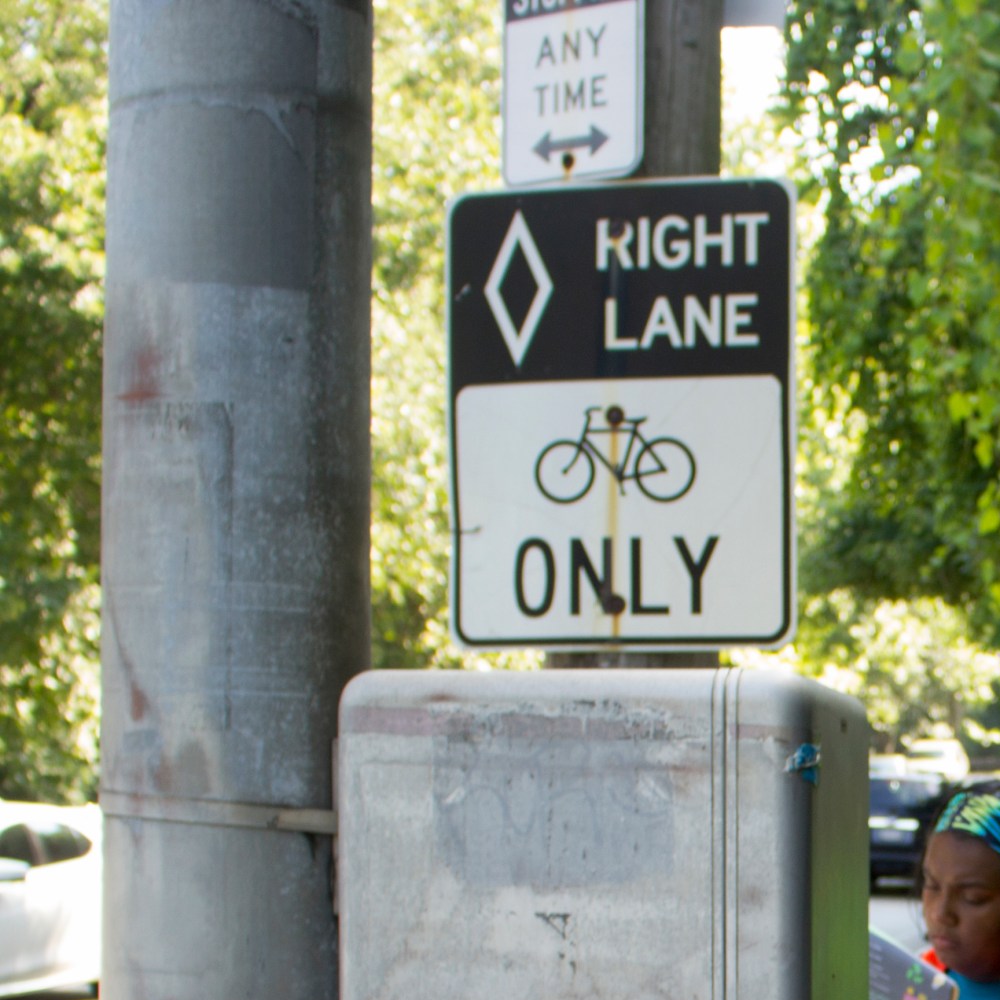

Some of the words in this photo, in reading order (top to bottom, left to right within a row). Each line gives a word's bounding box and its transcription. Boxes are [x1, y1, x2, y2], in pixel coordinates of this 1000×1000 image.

[535, 24, 607, 68] ANY
[534, 74, 608, 117] TIME
[595, 212, 770, 272] RIGHT
[604, 293, 760, 350] LANE
[514, 534, 720, 618] ONLY
